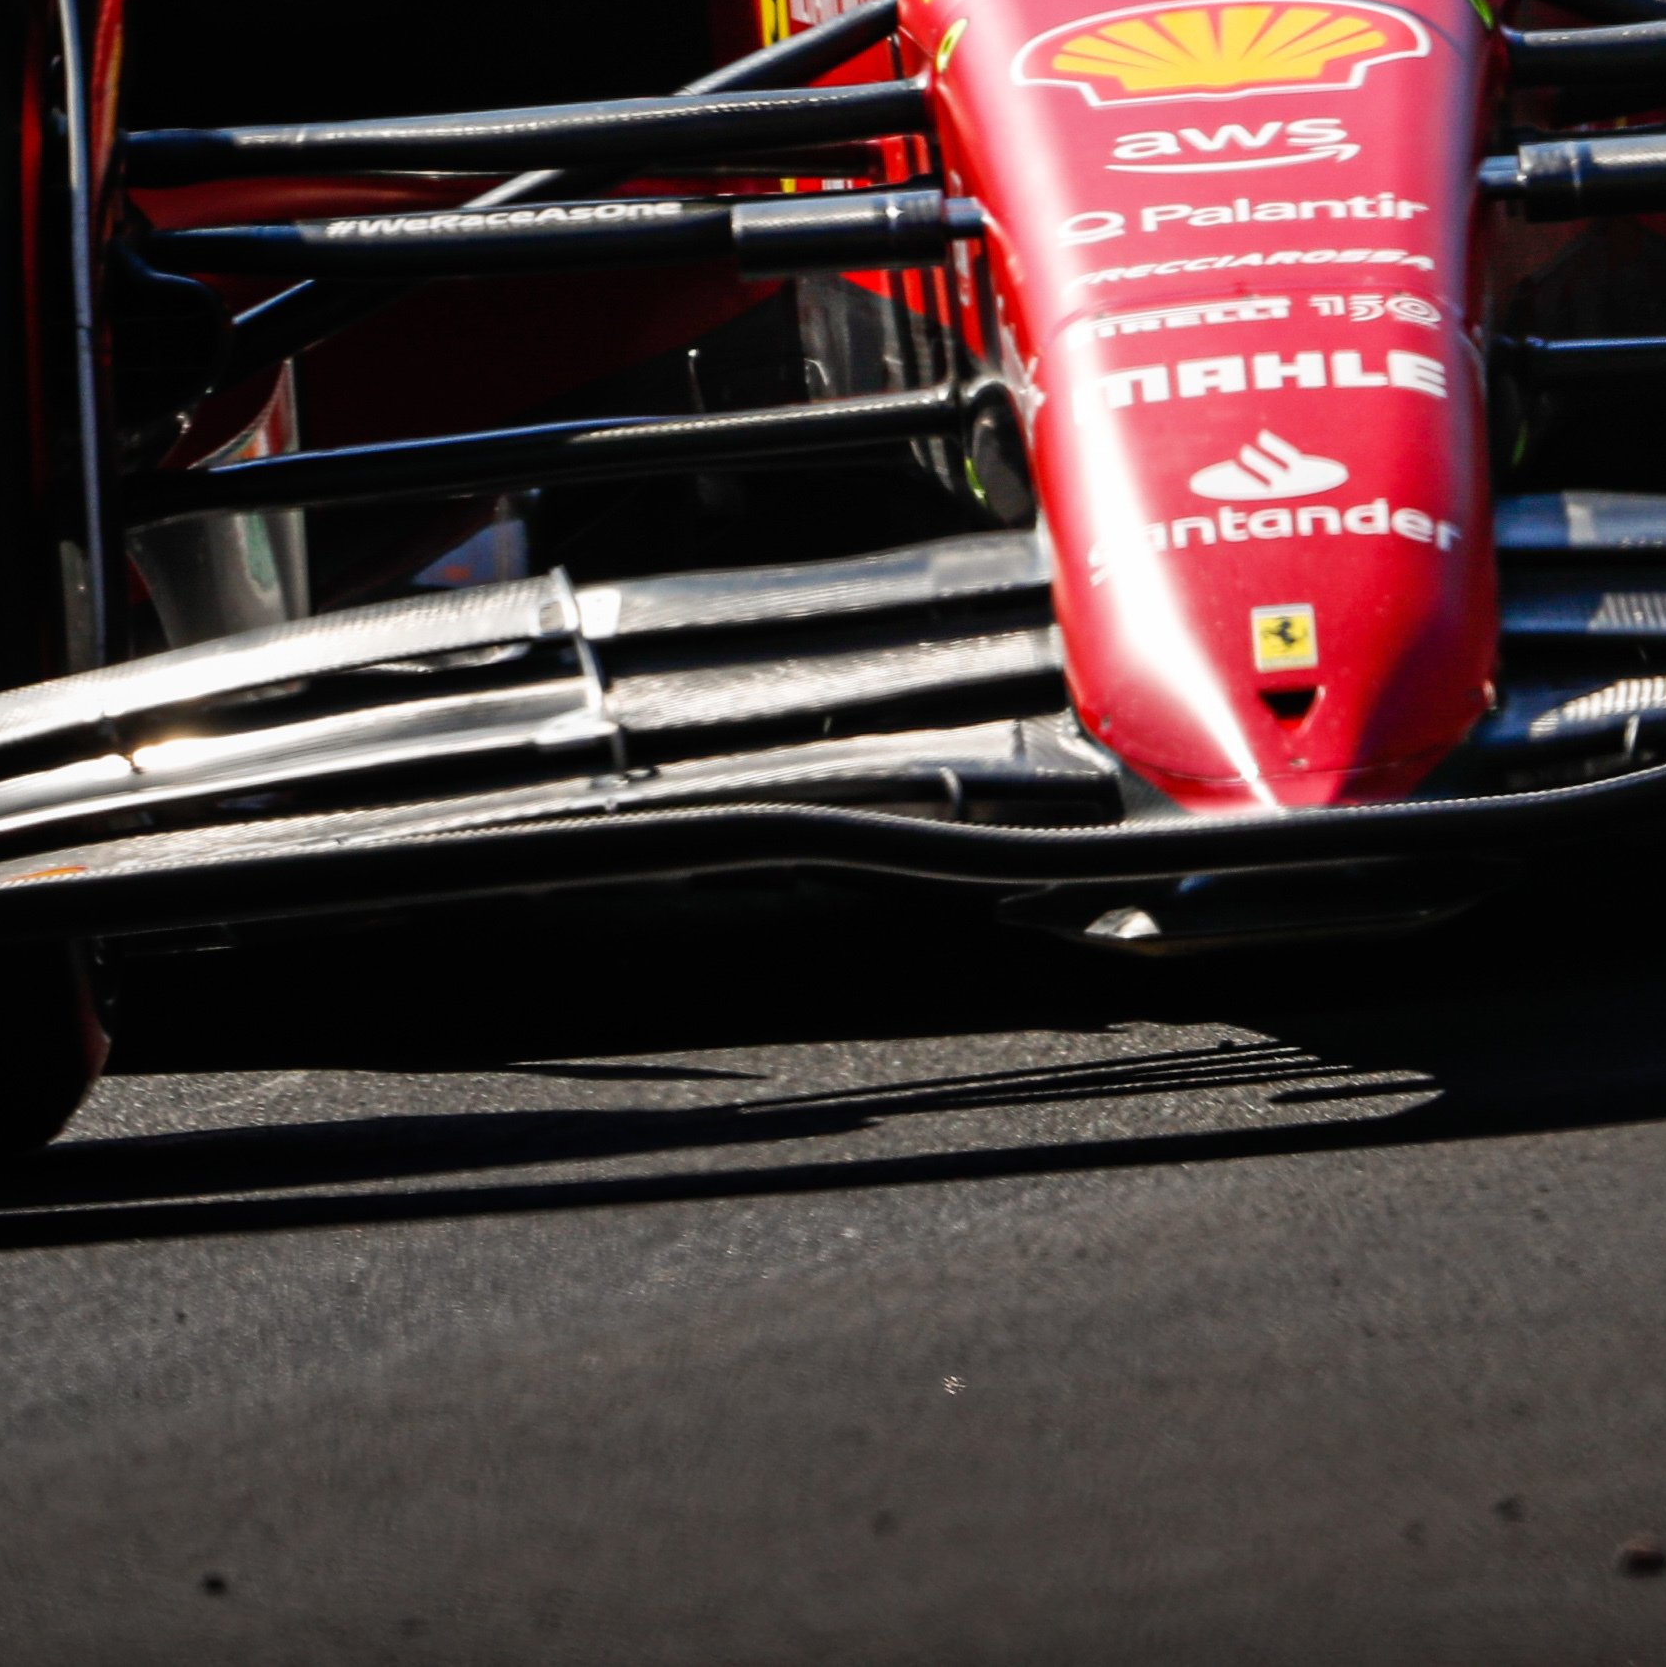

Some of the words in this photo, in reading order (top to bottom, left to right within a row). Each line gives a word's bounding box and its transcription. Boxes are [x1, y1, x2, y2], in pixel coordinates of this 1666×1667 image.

[1112, 117, 1348, 161] aws
[326, 201, 683, 239] #WeRaceAsOne
[1141, 192, 1430, 232] Palantir
[1074, 349, 1449, 416] MAHLE
